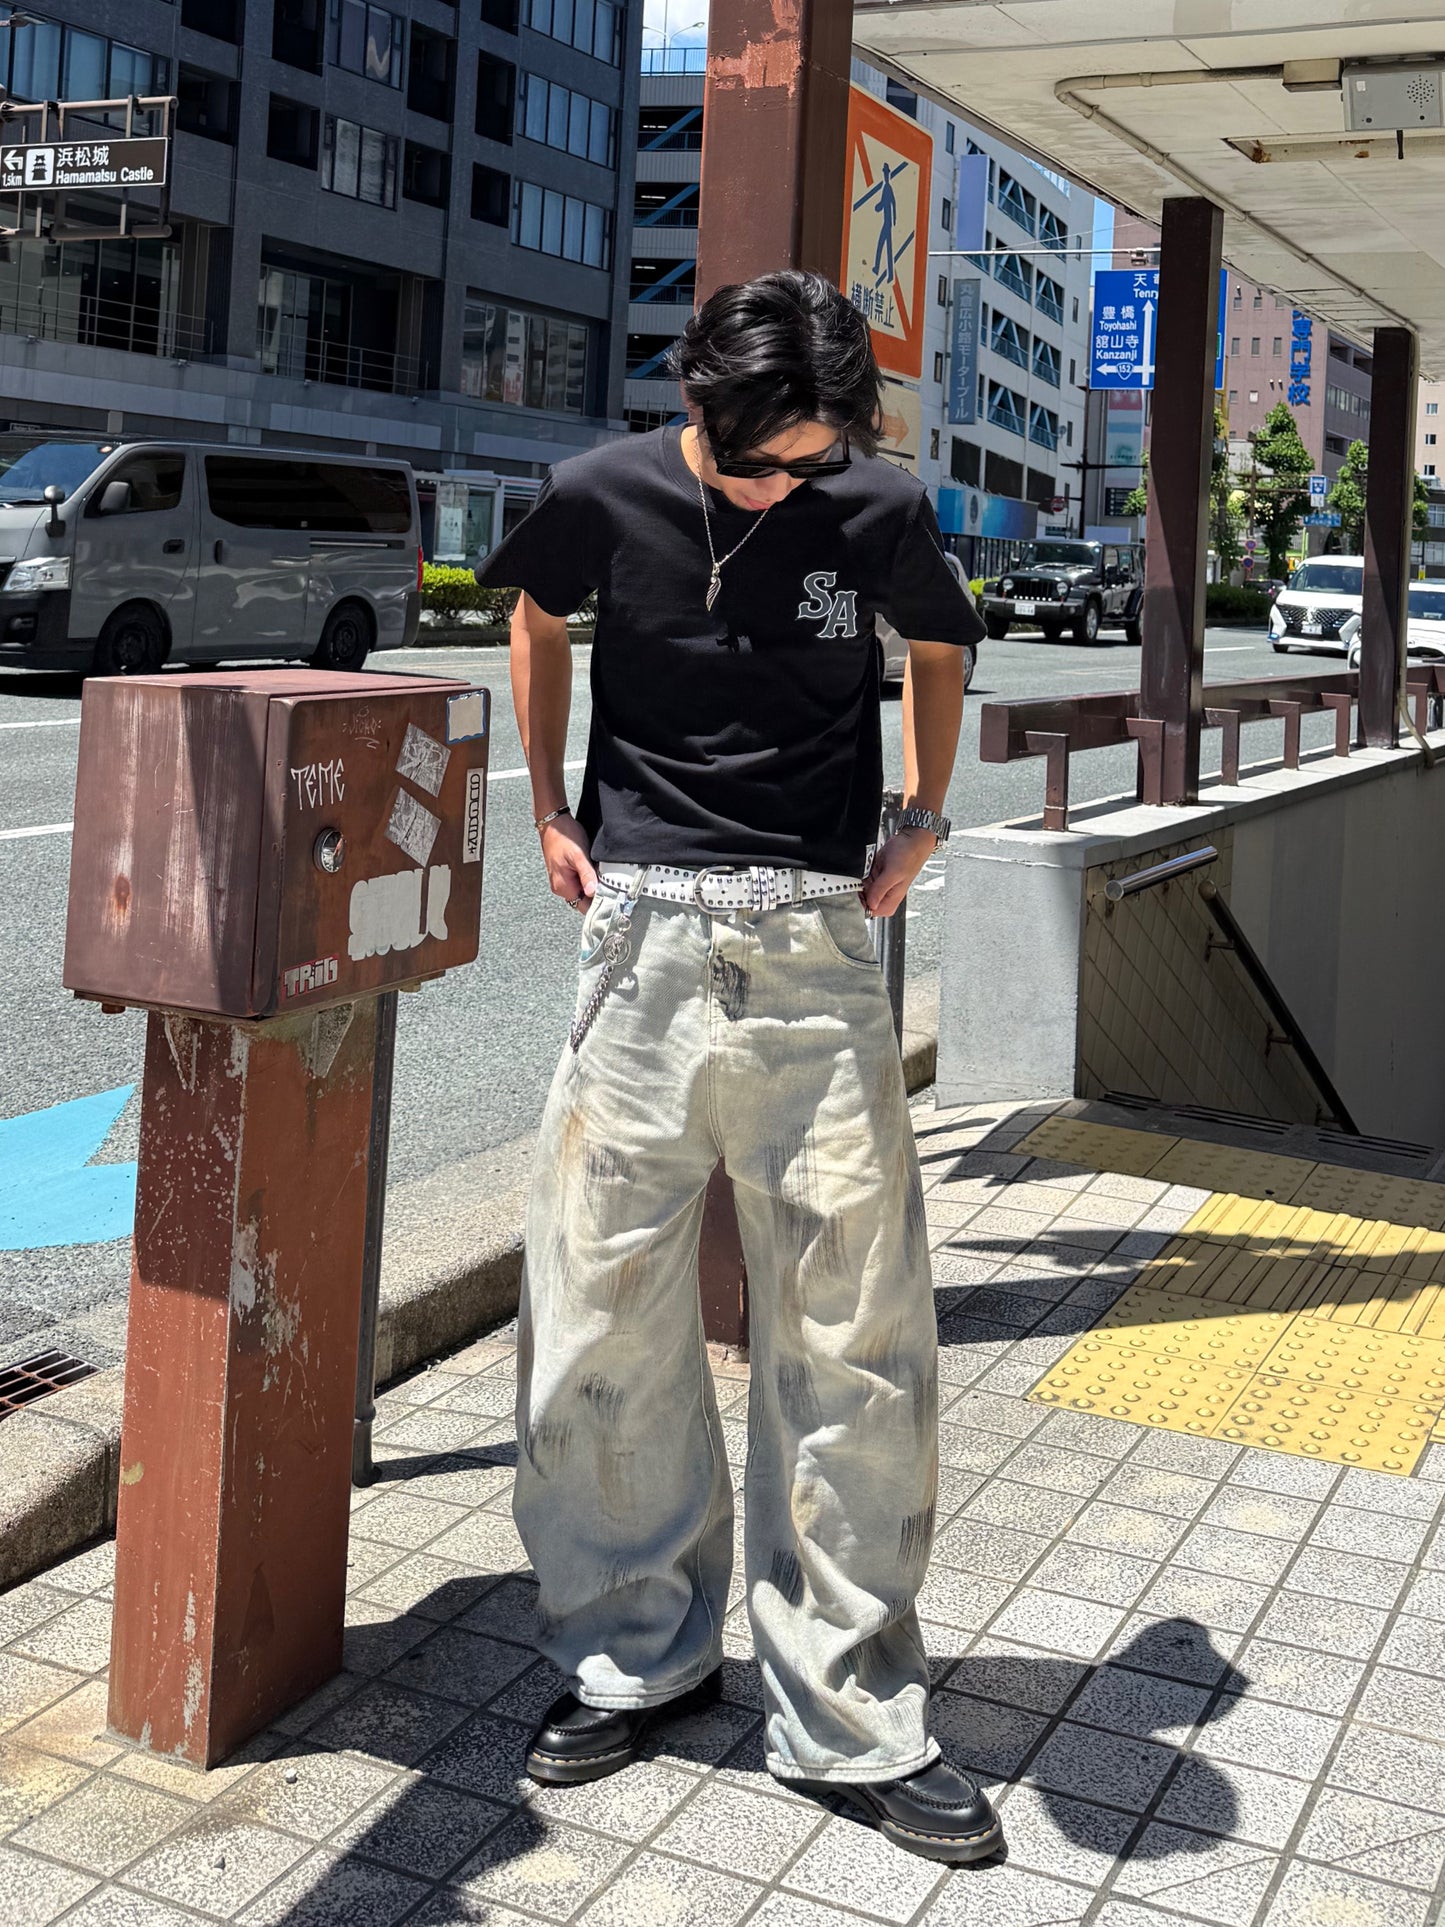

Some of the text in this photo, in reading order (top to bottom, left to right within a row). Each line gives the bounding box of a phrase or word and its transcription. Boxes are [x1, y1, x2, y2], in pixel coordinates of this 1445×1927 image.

[56, 146, 110, 168] 浜松城
[2, 172, 23, 187] 1.5km
[55, 166, 154, 185] Hamamatsu Castle
[851, 280, 895, 329] 横断禁止
[1099, 320, 1137, 332] Toyohashi
[1096, 349, 1137, 361] Kanzanji
[1118, 364, 1131, 374] 152
[290, 758, 345, 811] TEME
